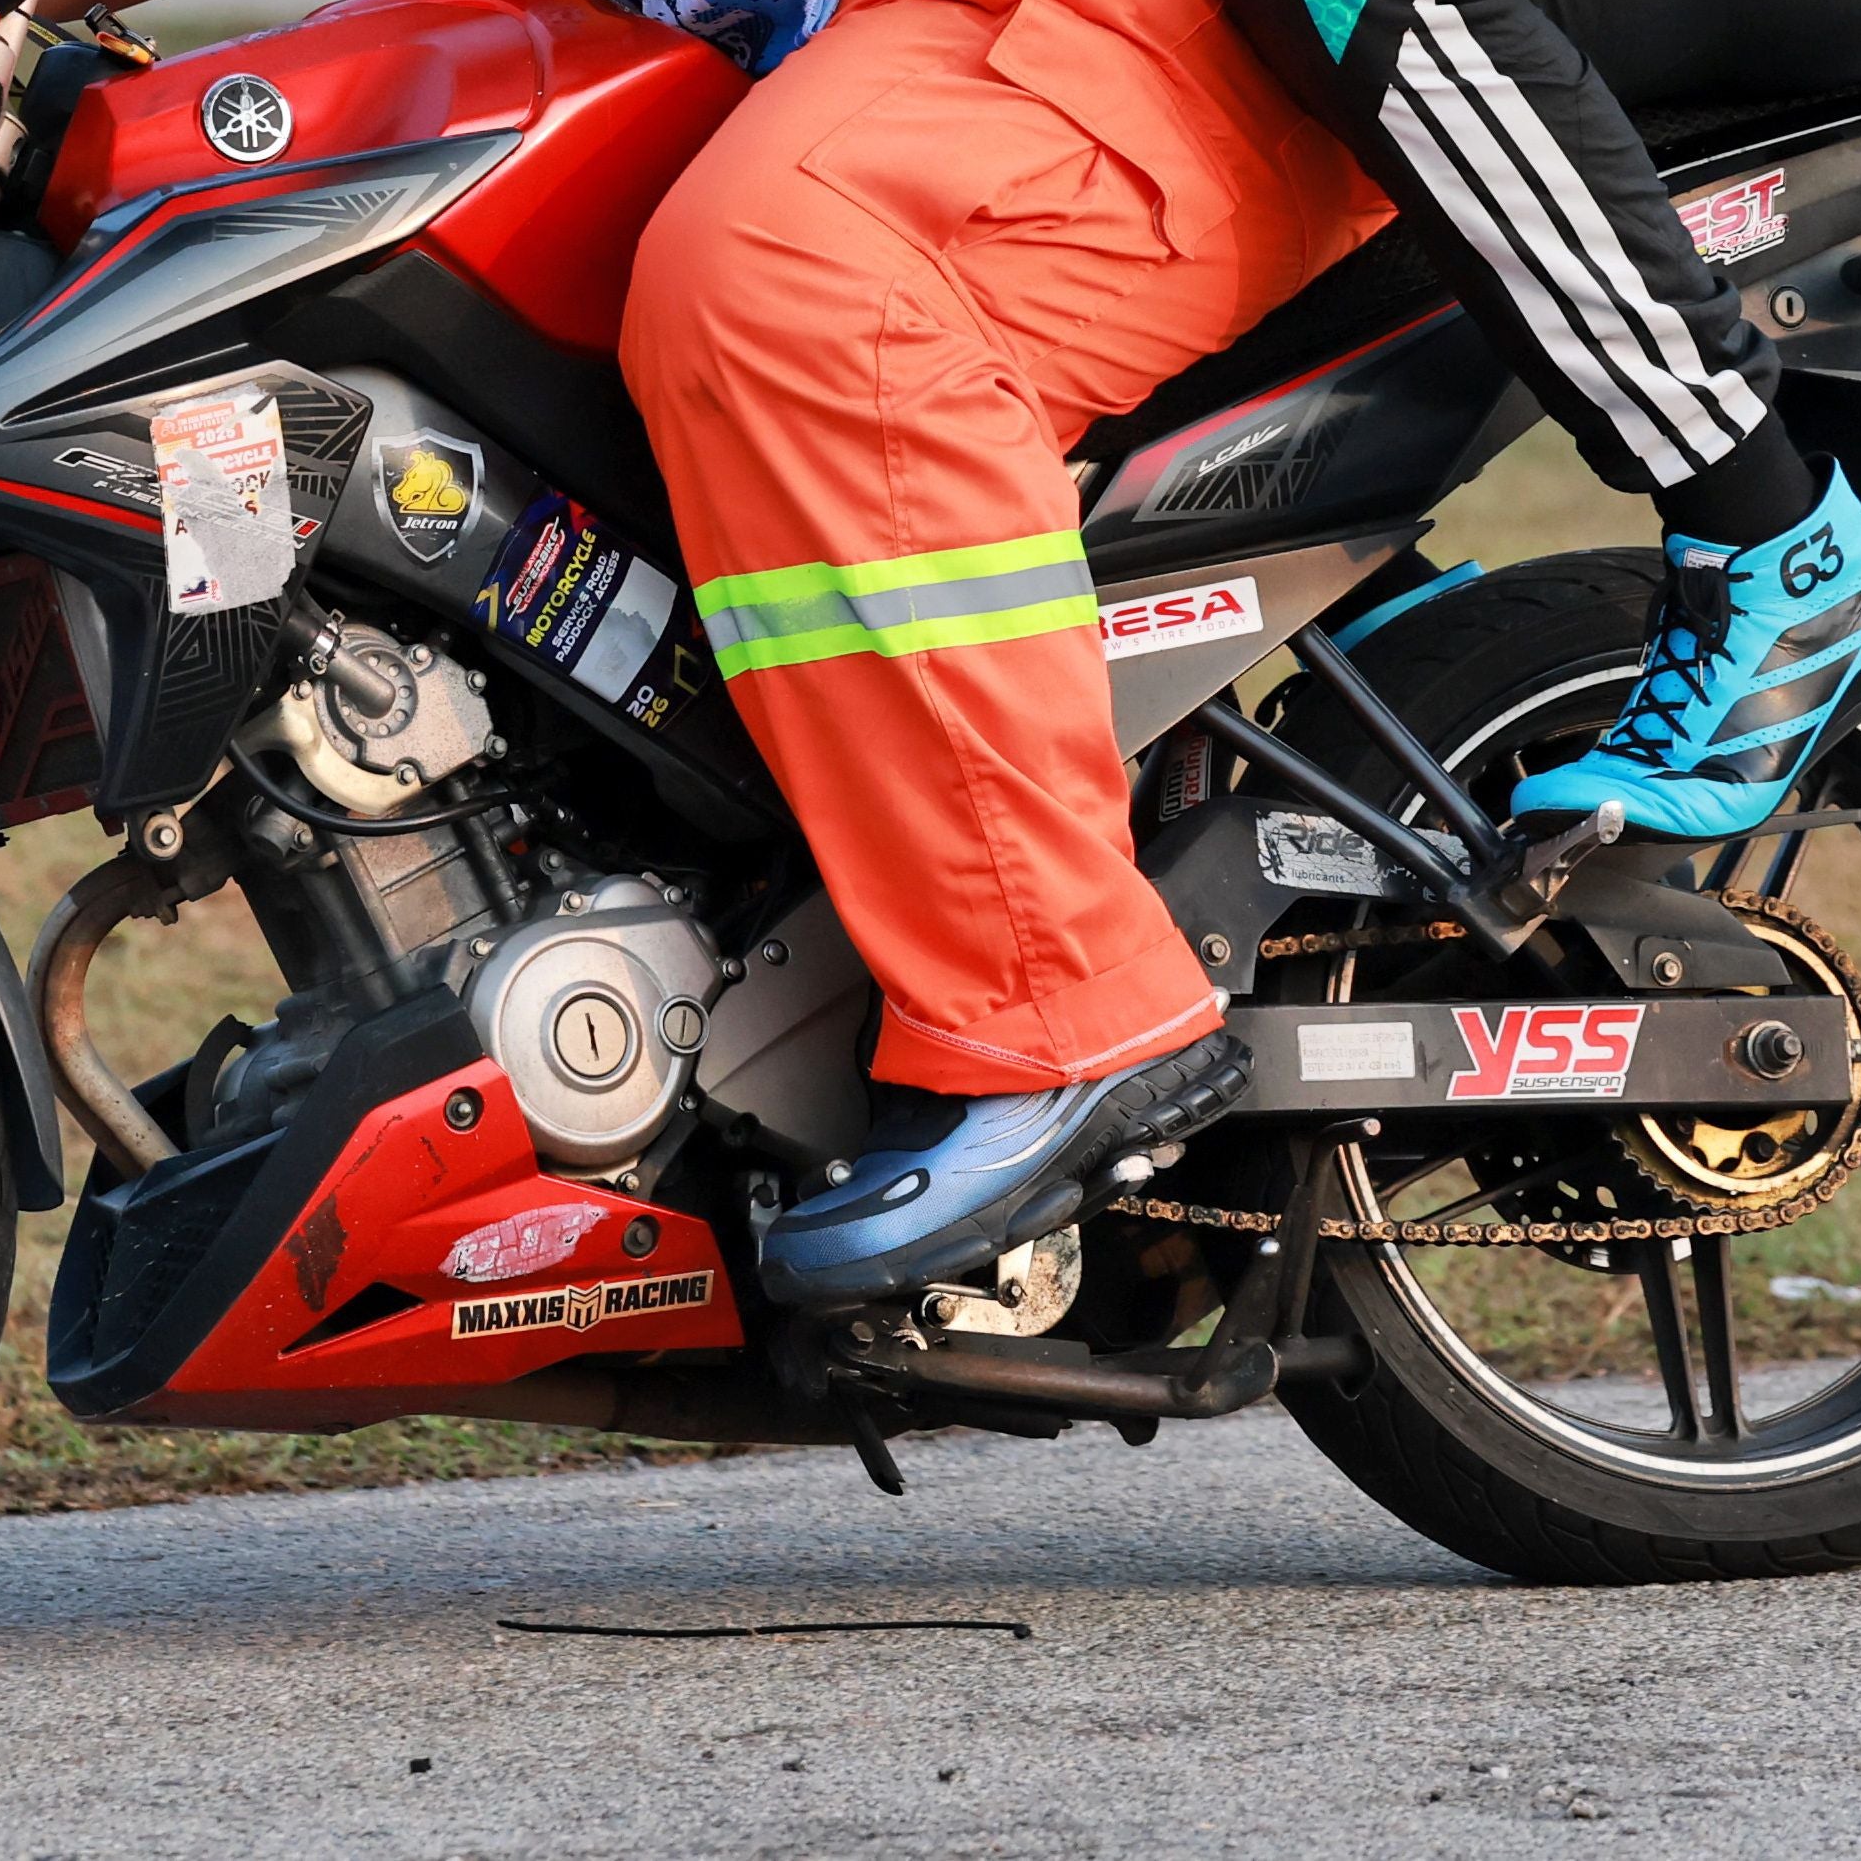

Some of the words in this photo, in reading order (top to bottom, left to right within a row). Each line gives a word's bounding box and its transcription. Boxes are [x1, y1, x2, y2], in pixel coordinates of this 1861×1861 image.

[400, 516, 458, 530] Jetron
[512, 529, 560, 606] SUPERBIKE
[525, 528, 597, 649] MOTORCYCLE
[1779, 521, 1845, 599] 63
[551, 590, 591, 648] SERVICE
[554, 600, 598, 664] PADDOCK
[593, 549, 621, 602] ACCESS
[1151, 628, 1186, 642] TIRE
[1195, 615, 1248, 634] TODAY
[1290, 867, 1346, 885] lubricants
[1449, 1008, 1640, 1098] YSS
[1512, 1076, 1623, 1090] SUSPENSION
[458, 1294, 566, 1335] MAXXIS
[603, 1275, 708, 1315] RACING
